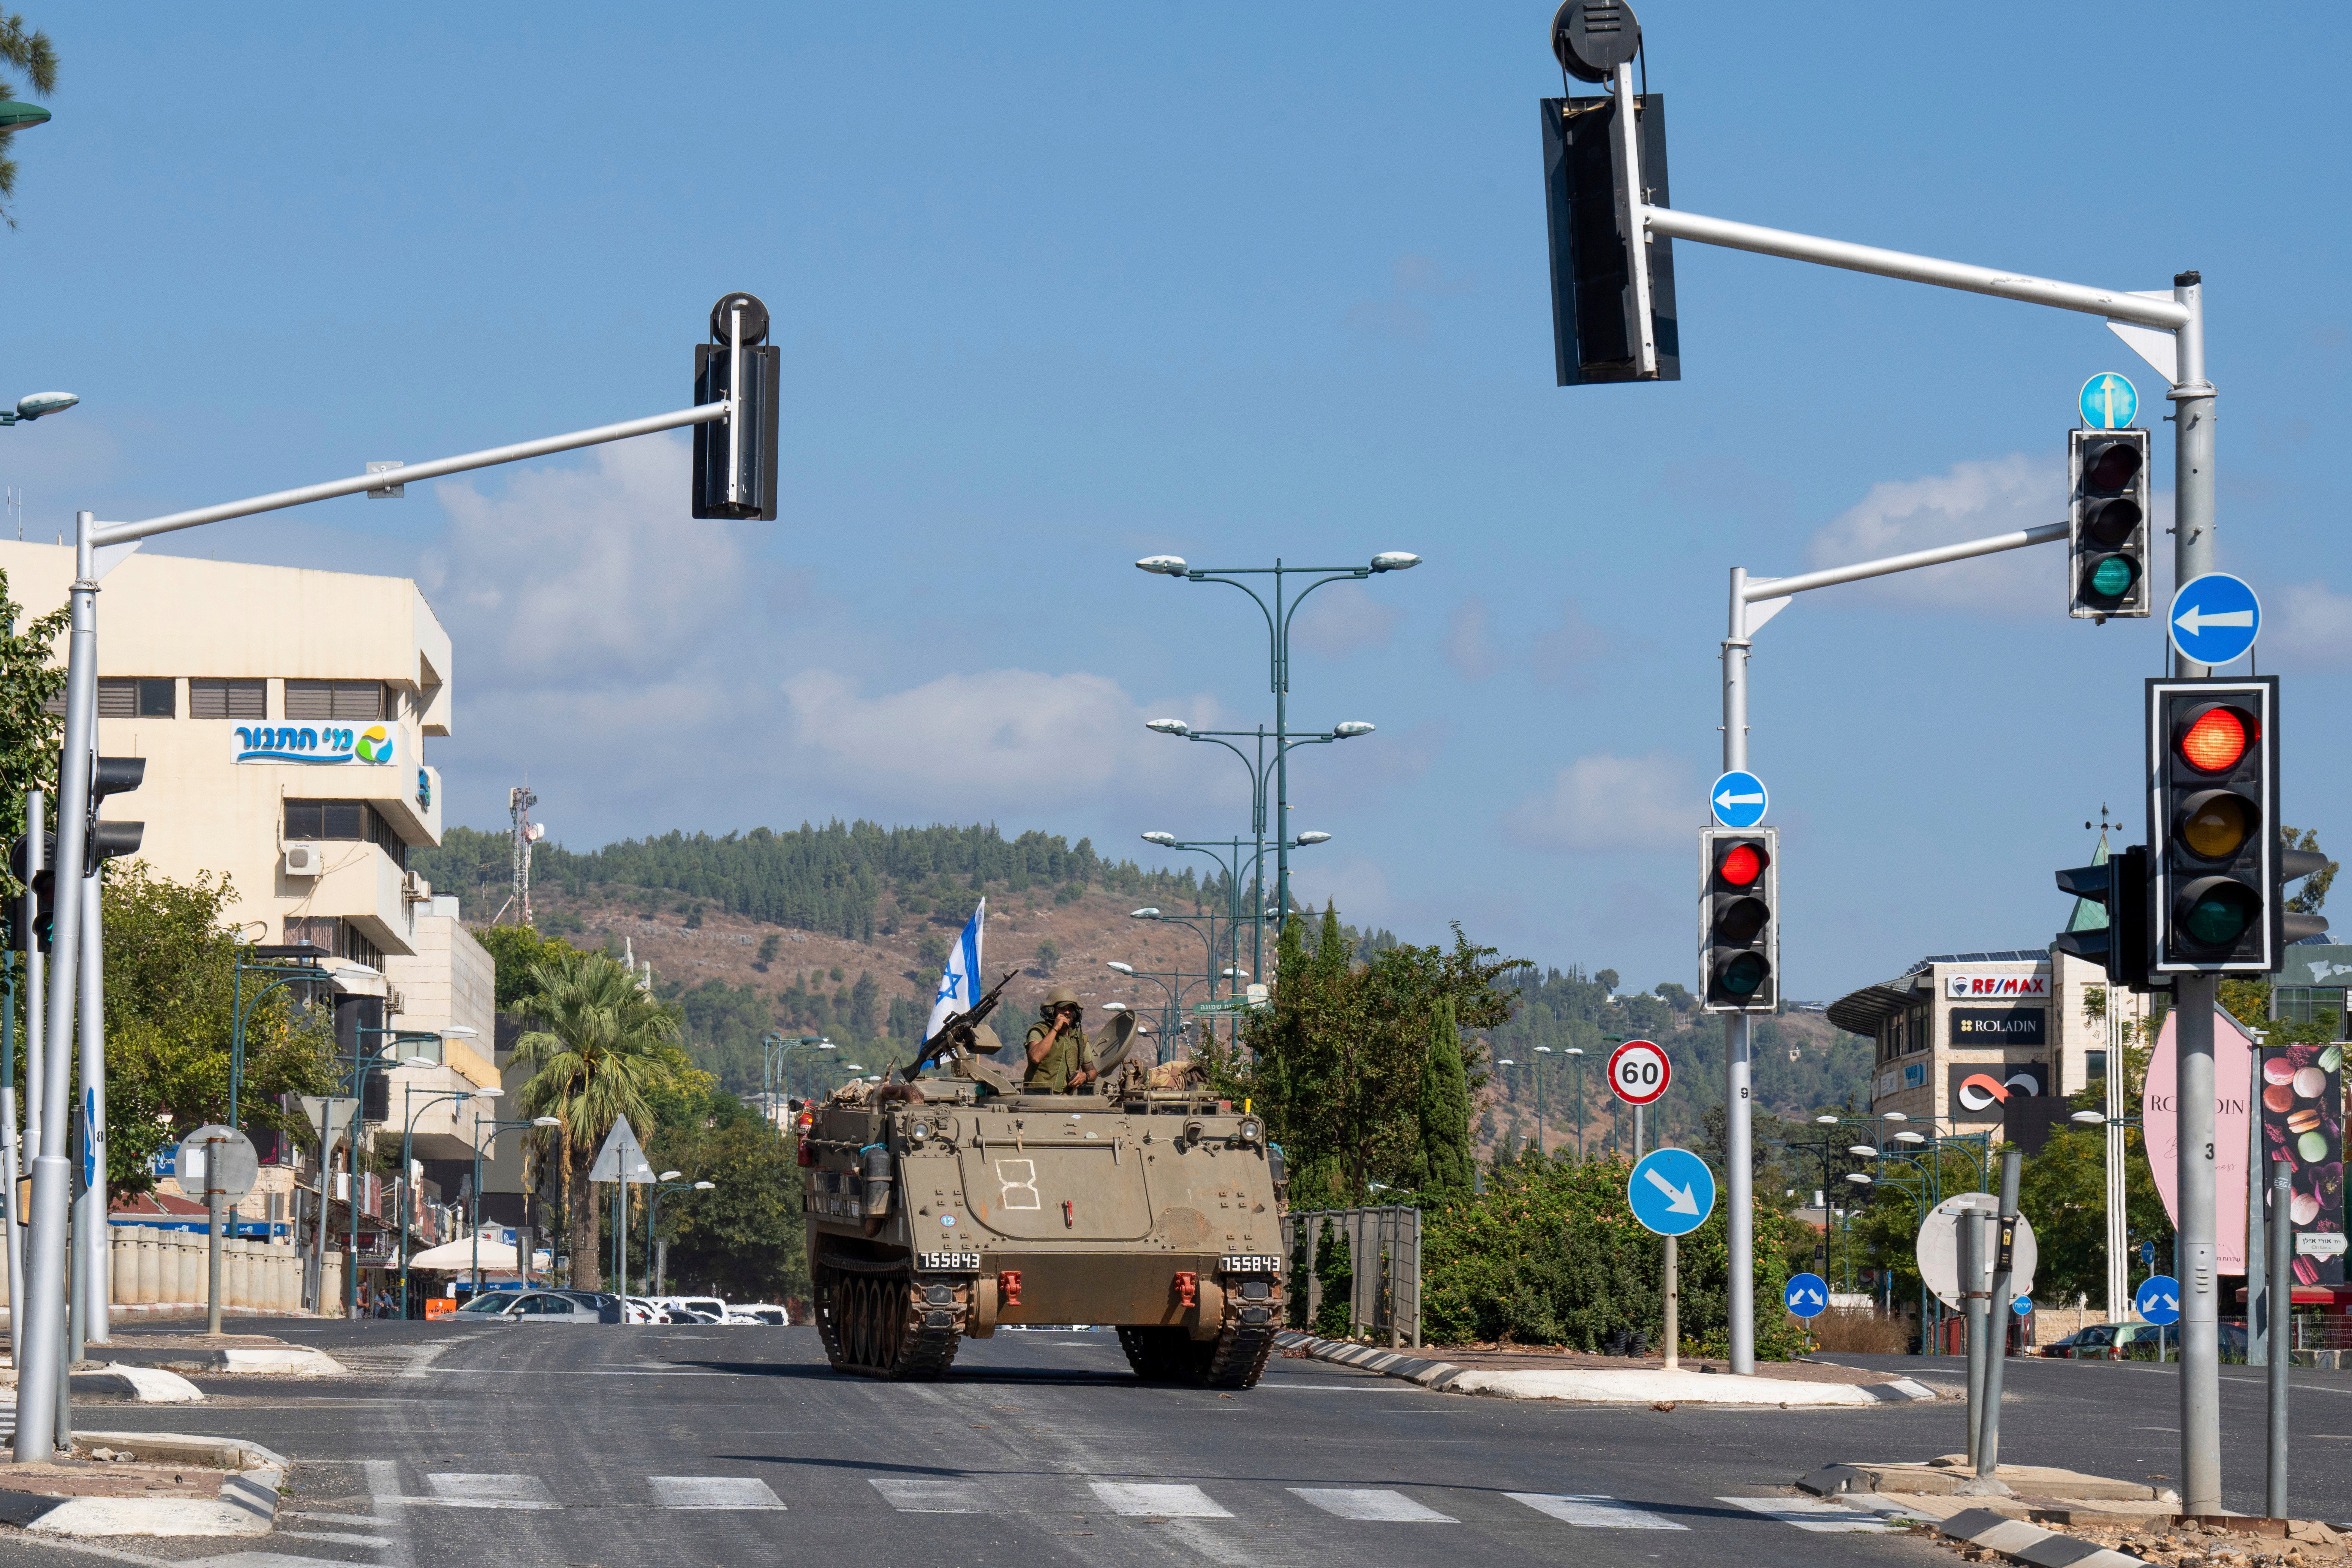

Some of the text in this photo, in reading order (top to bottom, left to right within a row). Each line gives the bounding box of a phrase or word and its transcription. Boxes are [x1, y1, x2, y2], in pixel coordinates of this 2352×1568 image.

[236, 727, 353, 748] מי התנור
[1973, 978, 2044, 994] RE/MAX
[1975, 1020, 2036, 1032] ROLADIN
[1622, 1062, 1658, 1084] 60
[1740, 1087, 1748, 1099] 9
[2150, 1095, 2244, 1114] RODIN
[97, 1130, 103, 1142] 8
[2205, 1143, 2214, 1160] 3
[920, 1253, 980, 1268] 755843
[1222, 1257, 1280, 1271] 755843
